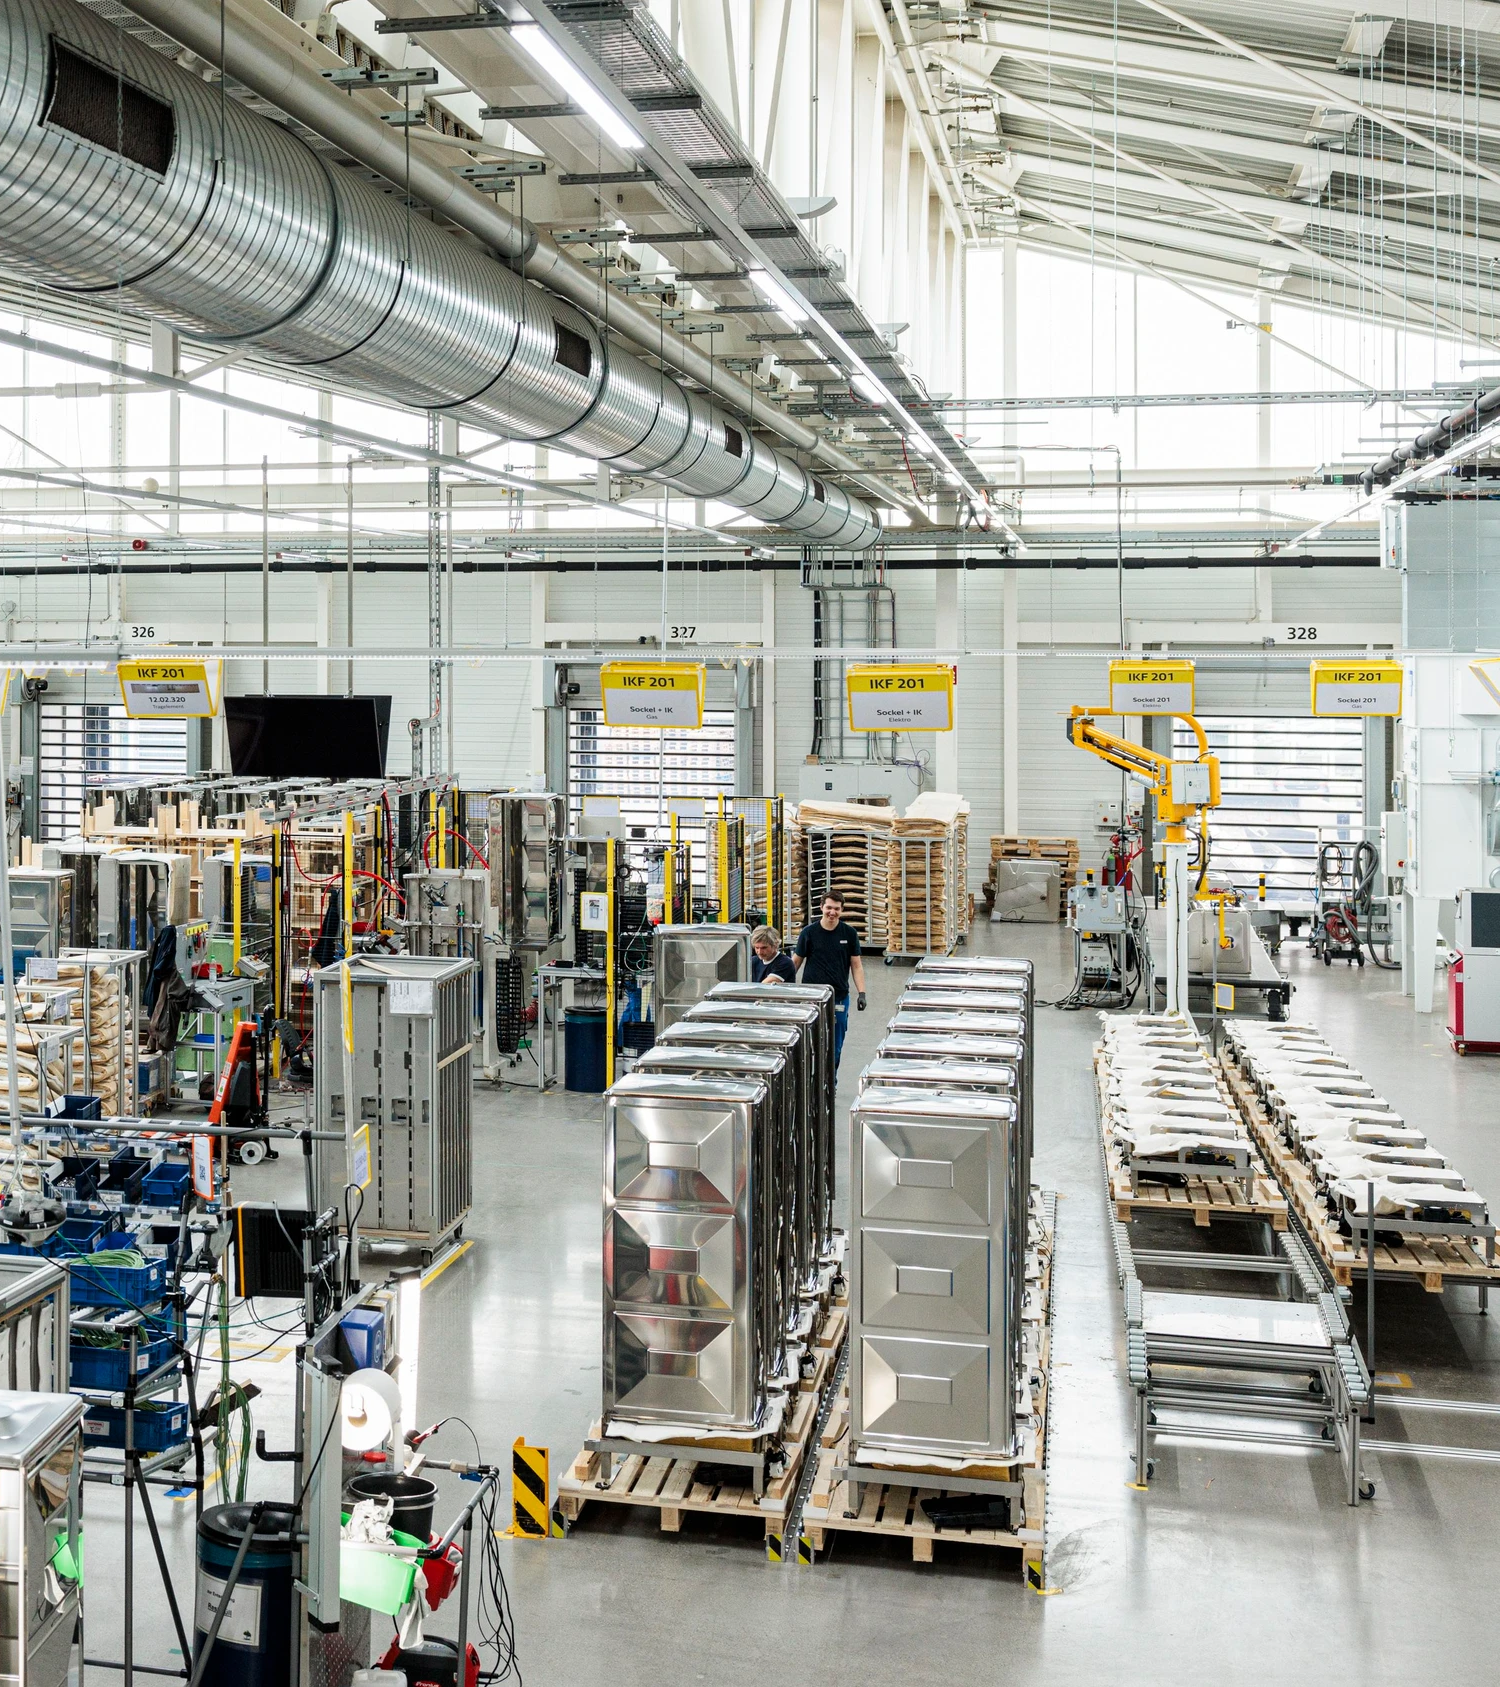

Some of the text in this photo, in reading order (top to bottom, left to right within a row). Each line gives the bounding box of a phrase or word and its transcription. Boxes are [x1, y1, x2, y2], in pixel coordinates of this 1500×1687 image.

[132, 627, 154, 638] 326
[671, 626, 696, 638] 327
[1288, 627, 1317, 640] 328
[138, 669, 185, 678] IKF 201
[1128, 673, 1174, 681] IKF 201
[1334, 673, 1381, 681] IKF 201
[623, 677, 675, 687] IKF 201
[870, 679, 924, 689] IKF 201
